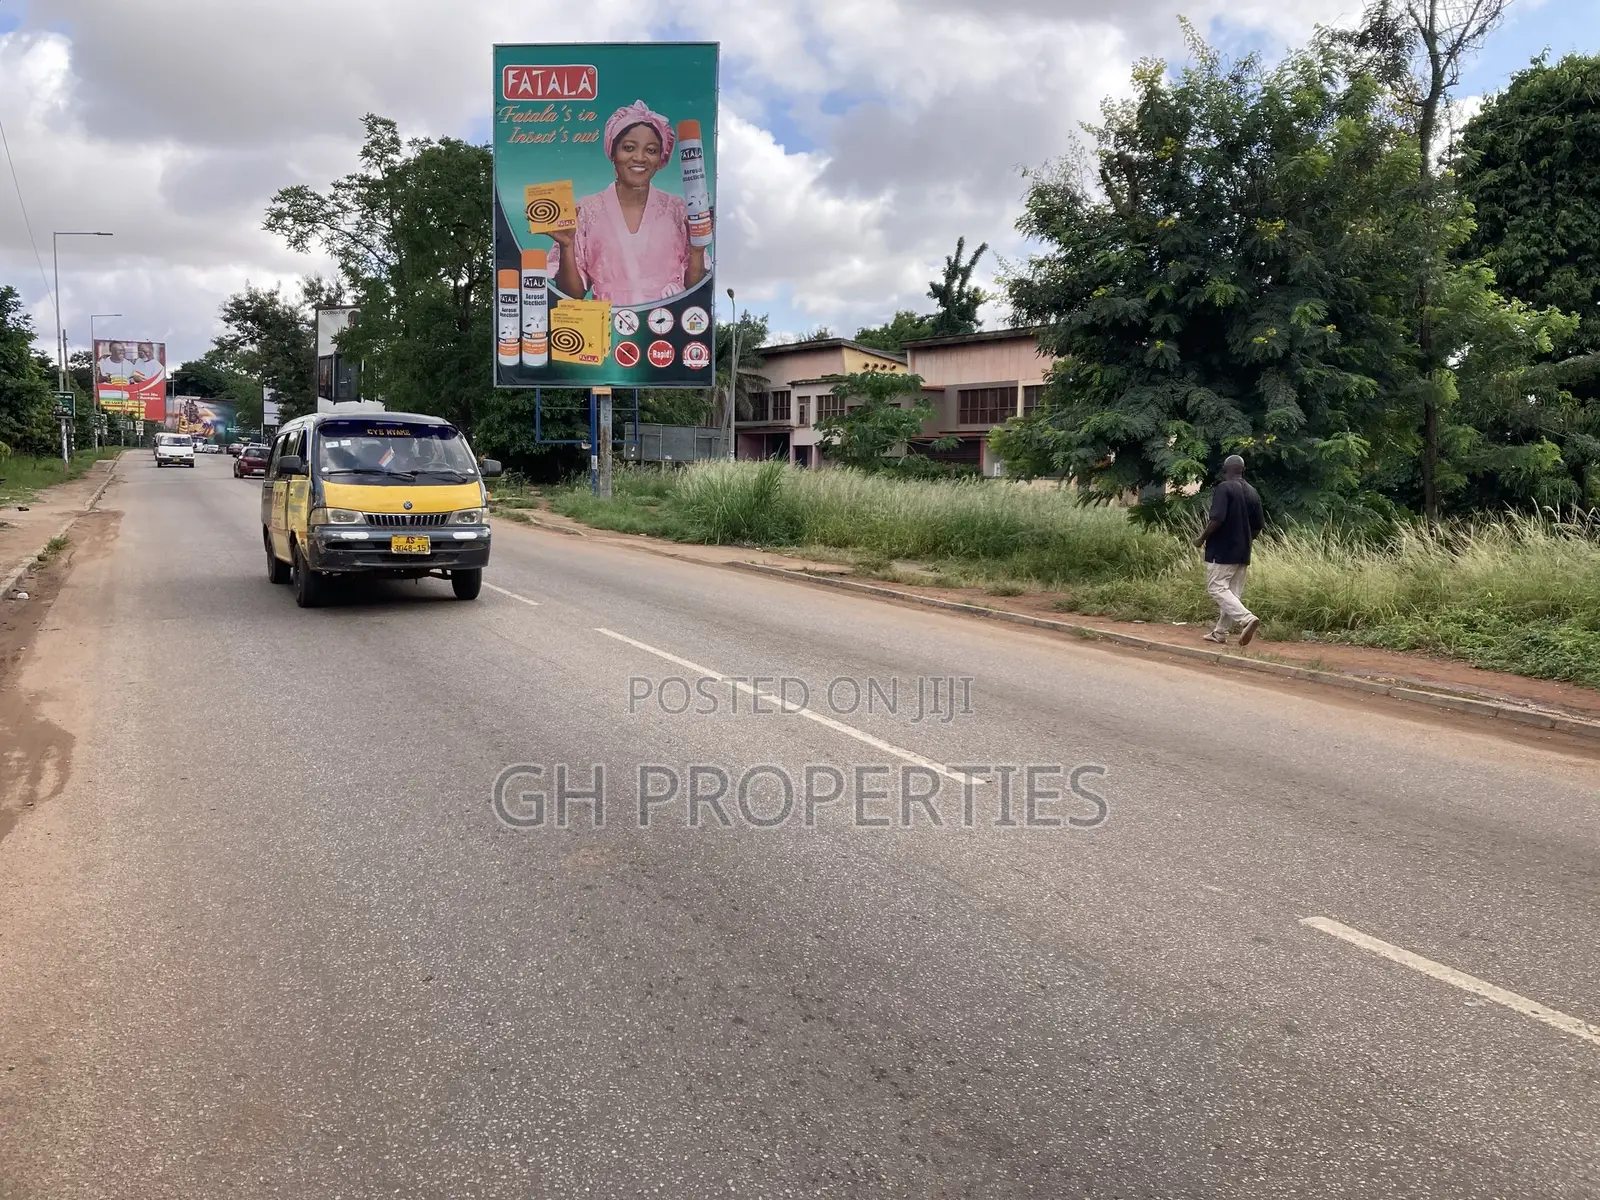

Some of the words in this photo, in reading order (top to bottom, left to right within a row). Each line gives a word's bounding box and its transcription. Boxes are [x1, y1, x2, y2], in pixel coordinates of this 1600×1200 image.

[507, 69, 593, 96] FATALA
[498, 103, 572, 124] Fatala's
[577, 109, 598, 122] in
[506, 125, 570, 143] Insect's
[572, 129, 600, 143] out
[394, 544, 426, 552] 3048-15
